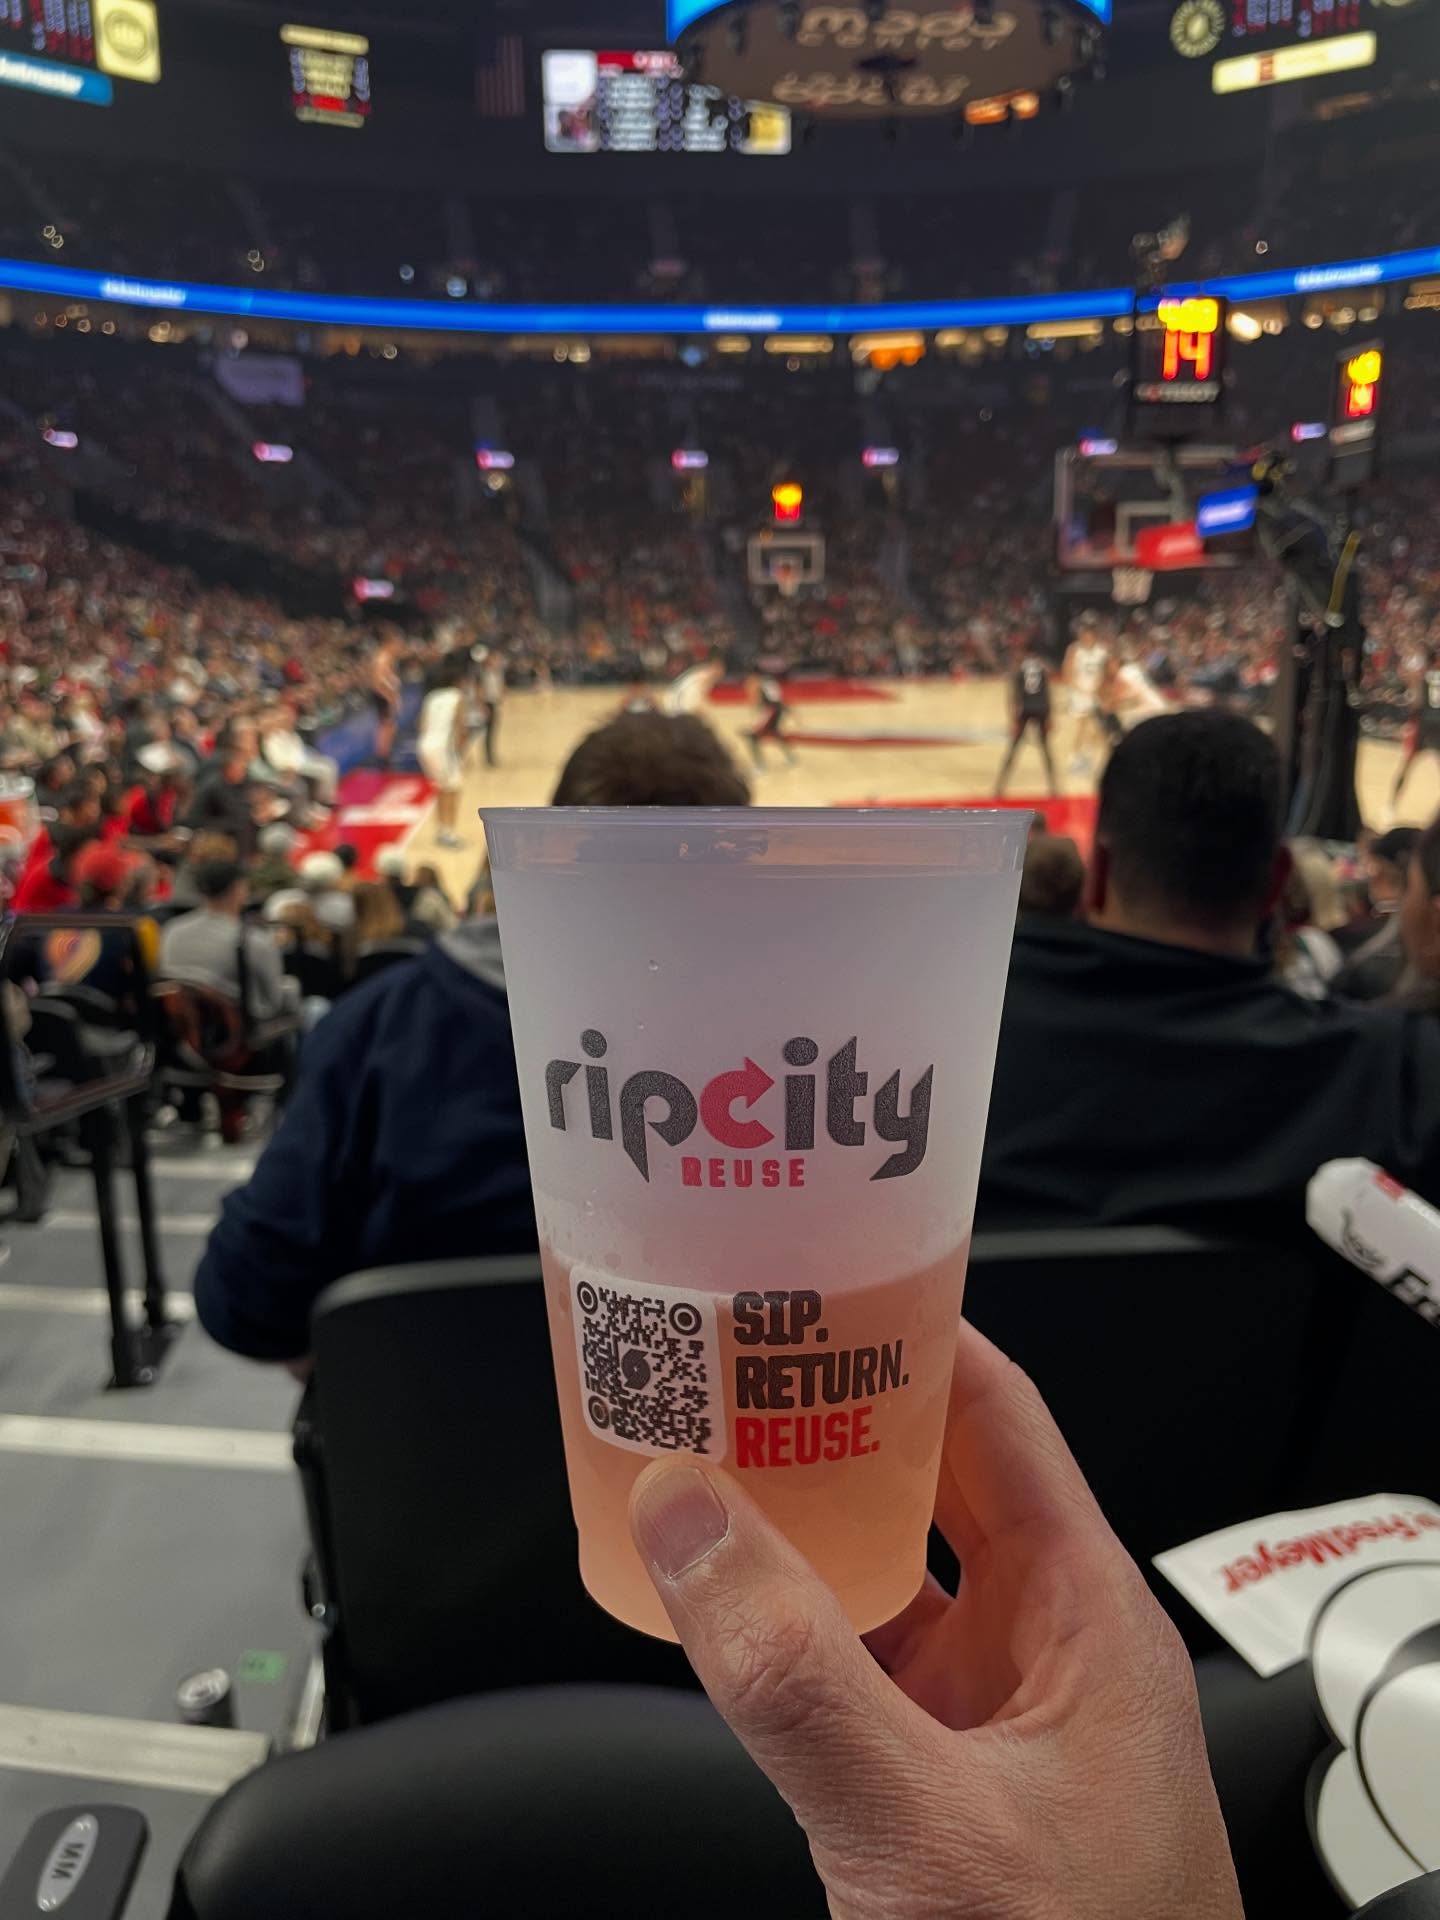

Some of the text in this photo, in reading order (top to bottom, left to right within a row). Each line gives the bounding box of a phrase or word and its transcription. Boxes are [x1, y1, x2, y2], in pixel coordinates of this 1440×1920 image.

[682, 1157, 805, 1188] REUSE
[732, 1289, 828, 1346] SIP.
[735, 1339, 909, 1410] RETURN.
[735, 1405, 880, 1468] REUSE.
